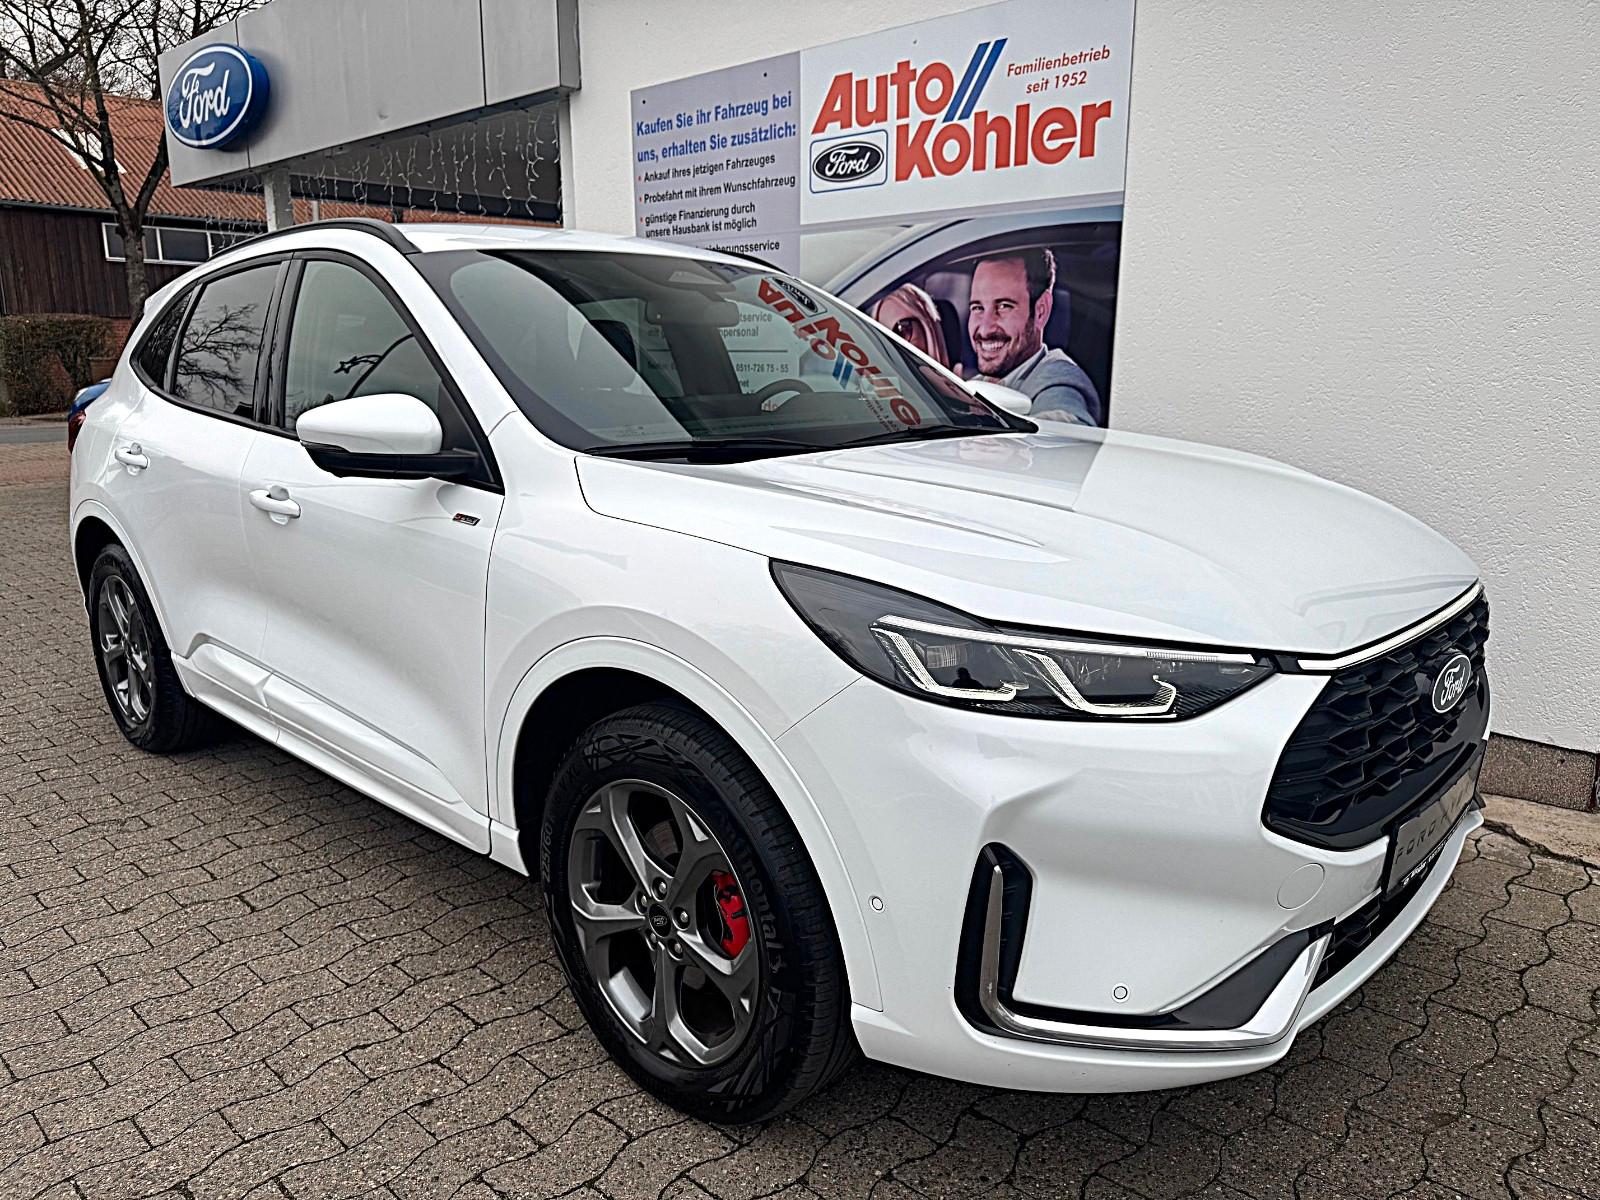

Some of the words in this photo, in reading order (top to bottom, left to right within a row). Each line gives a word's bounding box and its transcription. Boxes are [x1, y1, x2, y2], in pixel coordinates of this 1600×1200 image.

[1007, 44, 1111, 77] Familienbetrieb
[179, 61, 231, 129] Ford
[810, 60, 955, 135] Auto
[1025, 77, 1050, 94] seit
[1053, 70, 1088, 90] 1952
[636, 117, 673, 137] Kaufen
[675, 111, 694, 129] Sie
[696, 108, 712, 126] ihr
[714, 99, 769, 122] Fahrzeug
[772, 90, 792, 111] bei
[637, 147, 660, 164] uns,
[661, 138, 707, 160] erhalten
[709, 132, 728, 152] Sie
[730, 121, 797, 147] zusätzlich:
[643, 168, 671, 183] Ankauf
[671, 165, 692, 180] ihres
[692, 160, 725, 178] jetzigen
[725, 152, 776, 171] Fahrzeuges
[824, 146, 870, 179] Ford
[643, 187, 684, 204] Probefahrt
[684, 186, 698, 200] mit
[698, 183, 722, 198] ihrem
[723, 174, 796, 194] Wunschfahrzeug
[644, 210, 678, 226] günstige
[678, 204, 730, 221] Finanzierung
[730, 201, 756, 217] durch
[645, 226, 671, 238] unsere
[671, 222, 711, 237] Hausbank
[711, 220, 722, 232] ist
[723, 217, 757, 234] möglich
[1440, 663, 1466, 706] Ford
